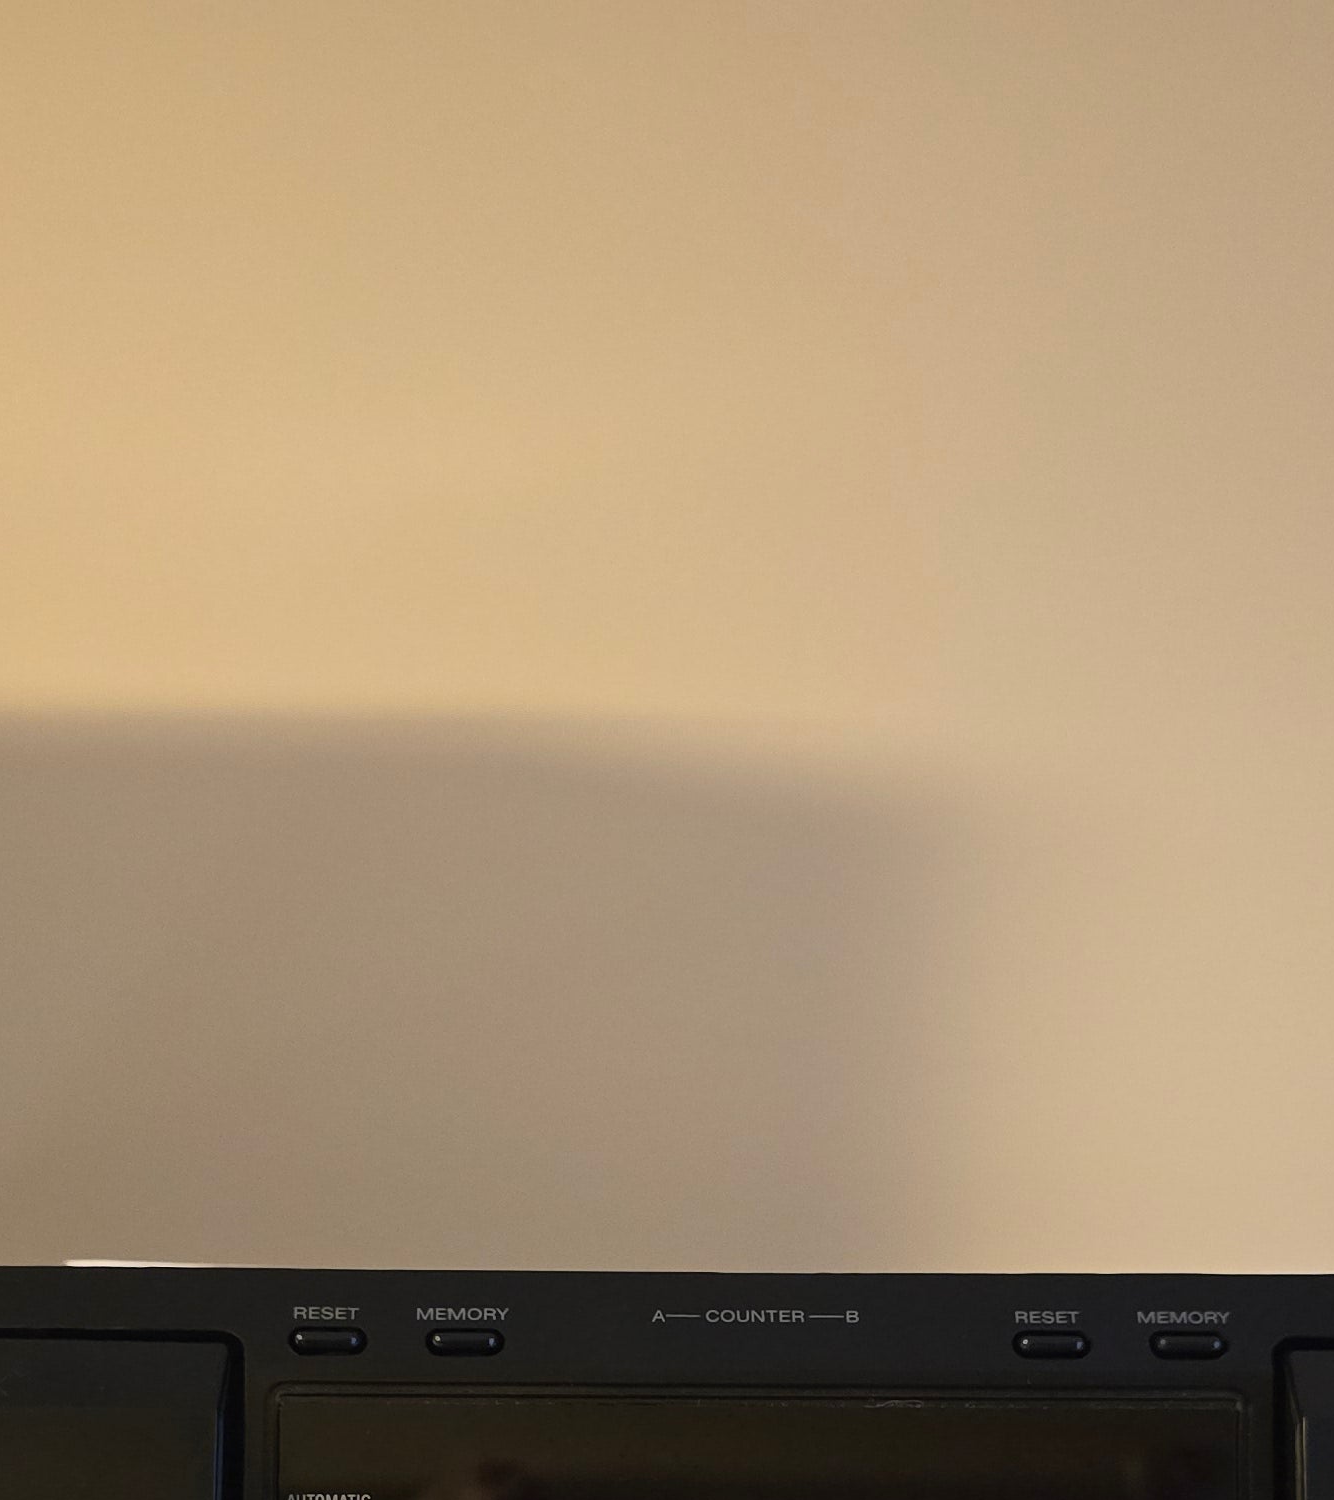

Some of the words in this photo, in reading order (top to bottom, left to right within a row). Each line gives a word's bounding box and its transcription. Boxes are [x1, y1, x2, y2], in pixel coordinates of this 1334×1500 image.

[293, 1307, 359, 1321] RESET
[417, 1307, 509, 1321] MEMORY
[705, 1310, 805, 1323] COUNTER
[1015, 1311, 1080, 1325] RESET
[1137, 1311, 1230, 1325] MEMORY
